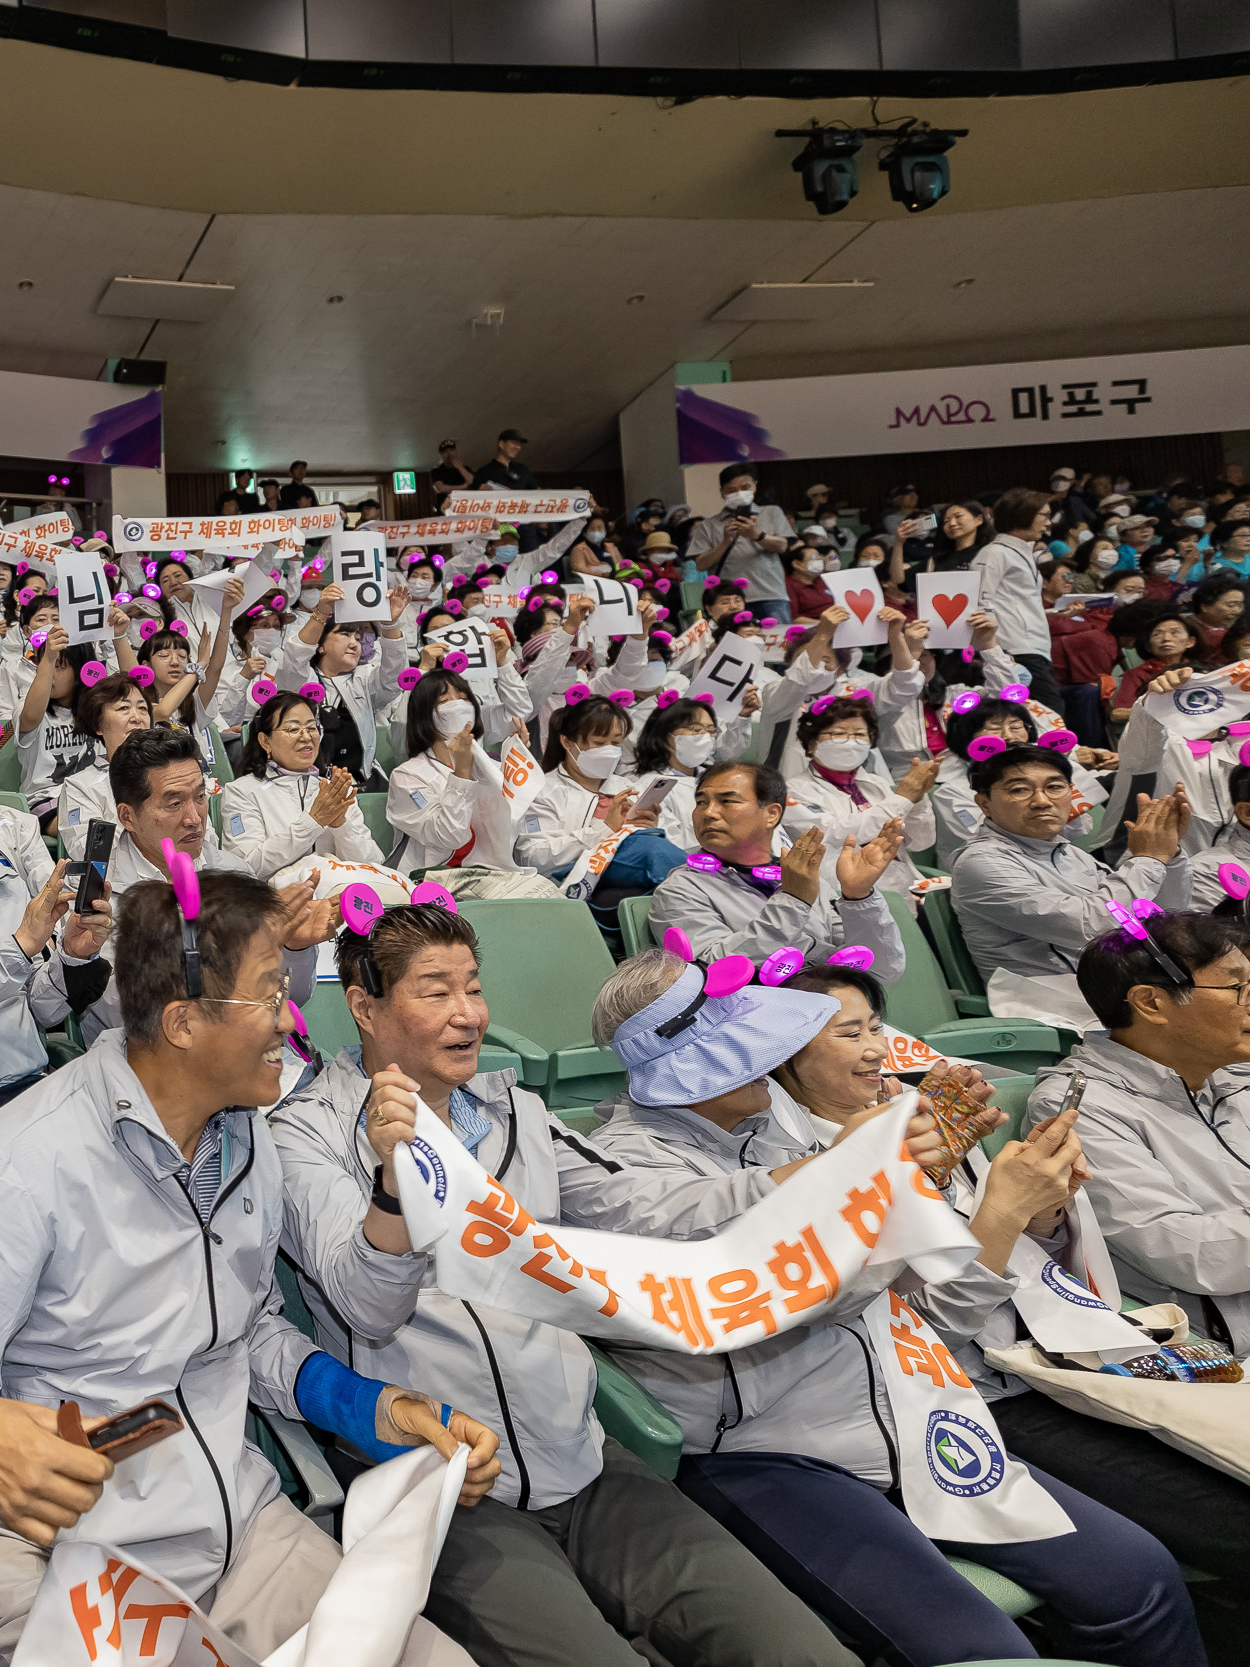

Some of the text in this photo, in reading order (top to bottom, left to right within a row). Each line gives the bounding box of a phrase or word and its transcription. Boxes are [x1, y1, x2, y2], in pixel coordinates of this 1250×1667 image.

[1011, 378, 1153, 422] 마포구
[34, 517, 76, 539] 화이팅!
[149, 521, 194, 542] 광진구
[198, 520, 243, 540] 체육회
[301, 513, 337, 530] 화이팅!
[341, 548, 385, 608] 랑
[593, 578, 634, 617] 니
[67, 571, 105, 632] 님
[437, 624, 488, 669] 합
[708, 653, 754, 702] 다
[353, 895, 374, 916] 광진
[638, 1223, 841, 1348] 체육회
